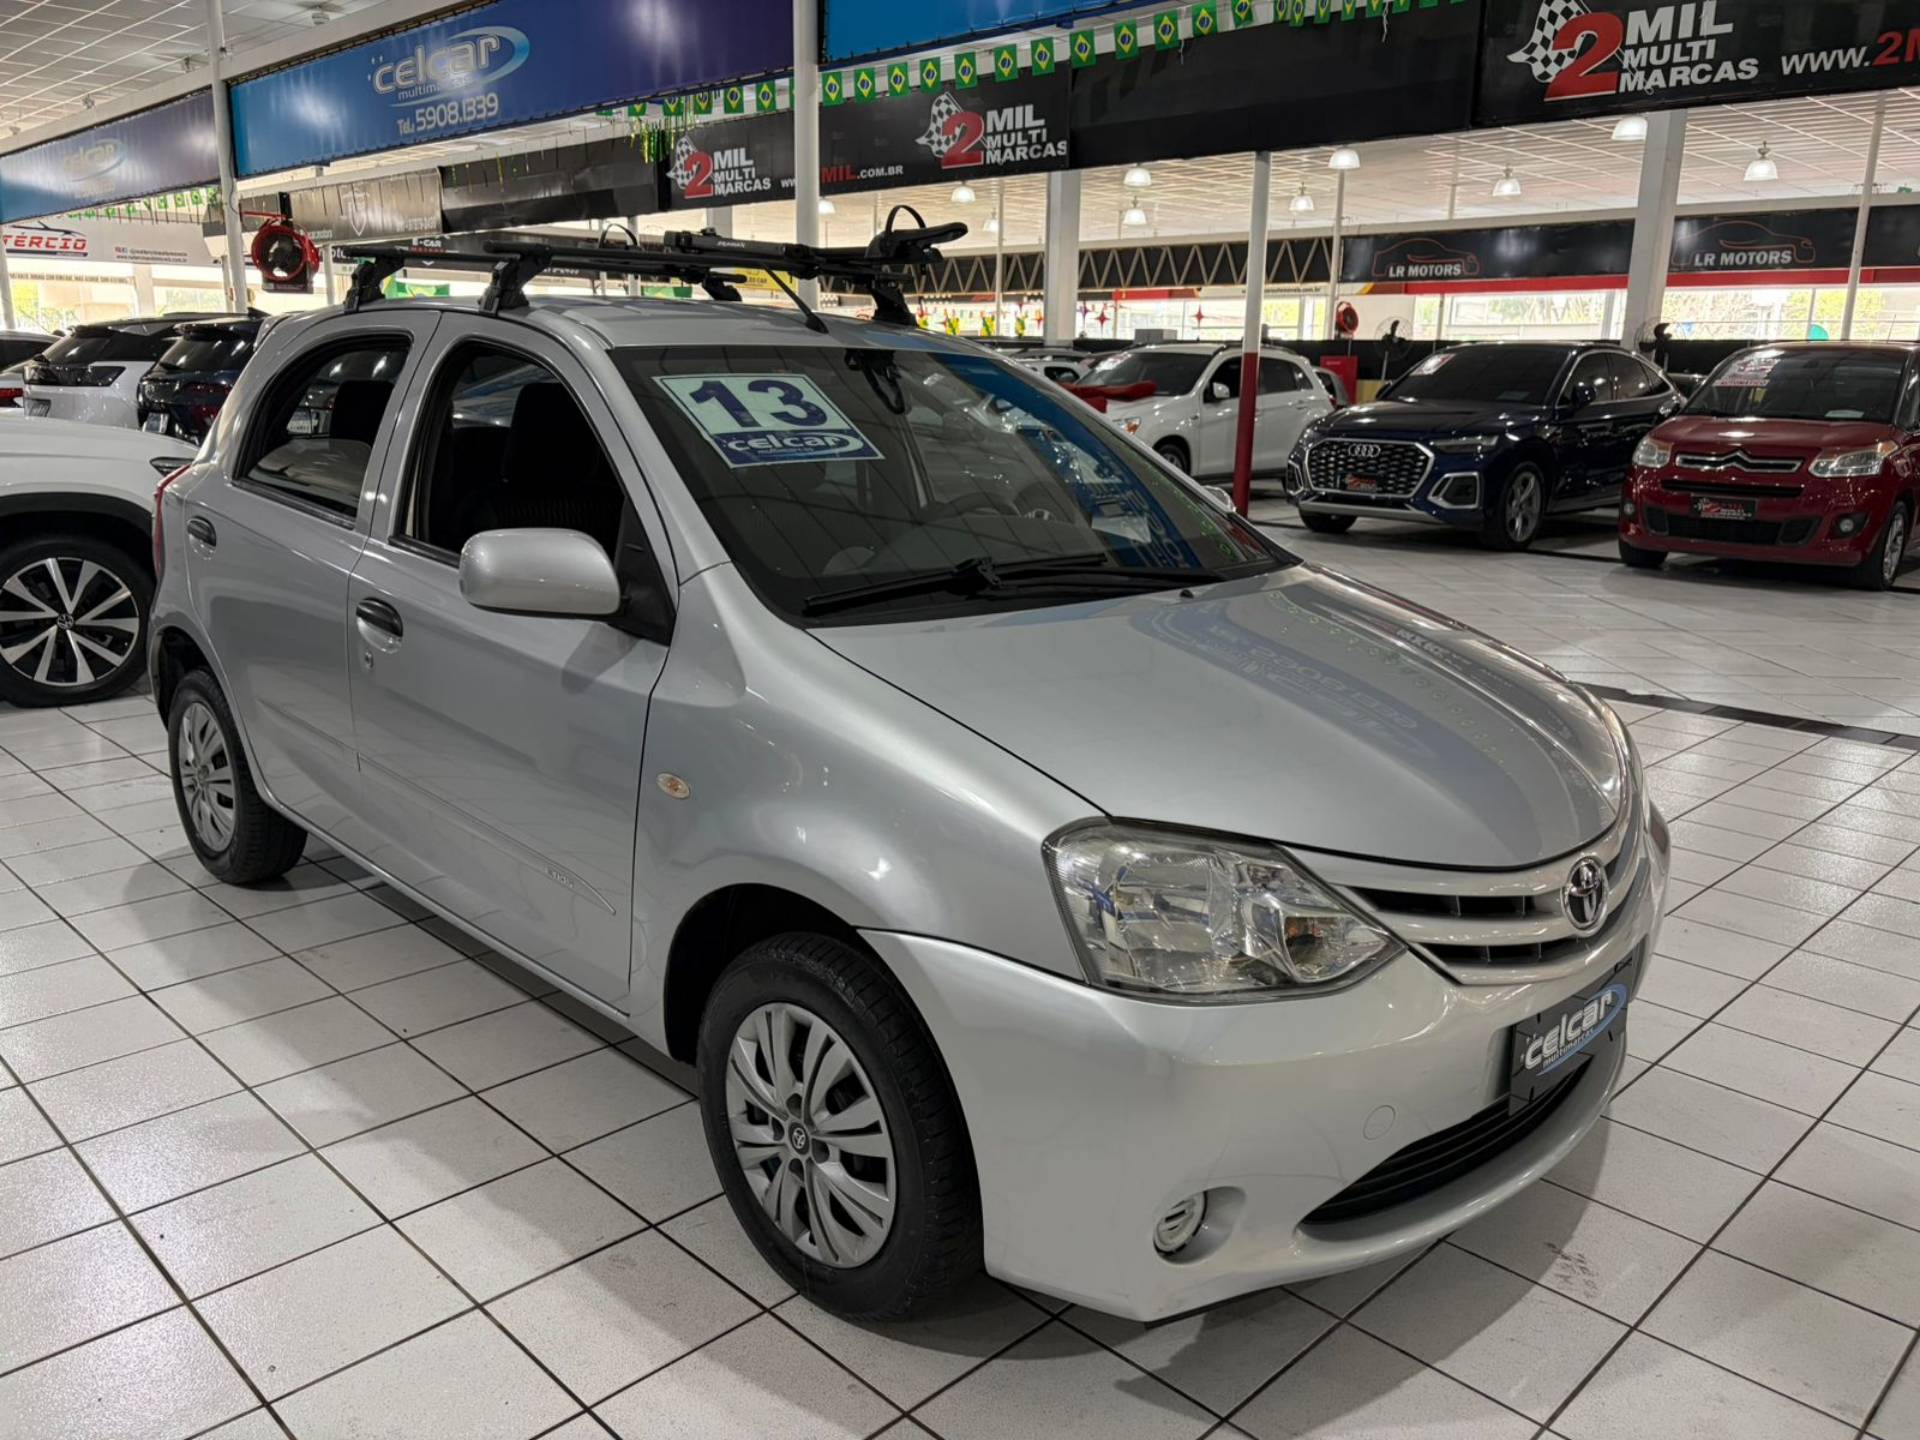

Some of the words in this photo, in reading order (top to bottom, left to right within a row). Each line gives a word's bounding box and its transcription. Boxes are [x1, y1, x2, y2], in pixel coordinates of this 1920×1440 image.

[373, 34, 500, 94] celcar
[1544, 12, 1624, 102] 2
[1625, 0, 1735, 46] MIL
[1622, 39, 1717, 69] MULTI
[1619, 58, 1760, 93] MARCAS
[942, 111, 985, 170] 2
[986, 104, 1046, 134] MIL
[986, 128, 1047, 149] MULTI
[986, 140, 1068, 166] MARCAS
[685, 152, 714, 199] 2
[713, 148, 754, 170] MIL
[713, 167, 756, 182] MULTI
[714, 178, 772, 196] MARCAS
[2, 232, 87, 250] TÉRCIO
[1388, 265, 1405, 278] LR
[1407, 263, 1461, 278] MOTORS
[1694, 253, 1716, 267] LR
[1719, 250, 1793, 266] MOTORS
[689, 379, 828, 428] 13
[726, 433, 842, 452] celcar
[1525, 989, 1613, 1070] celcar
